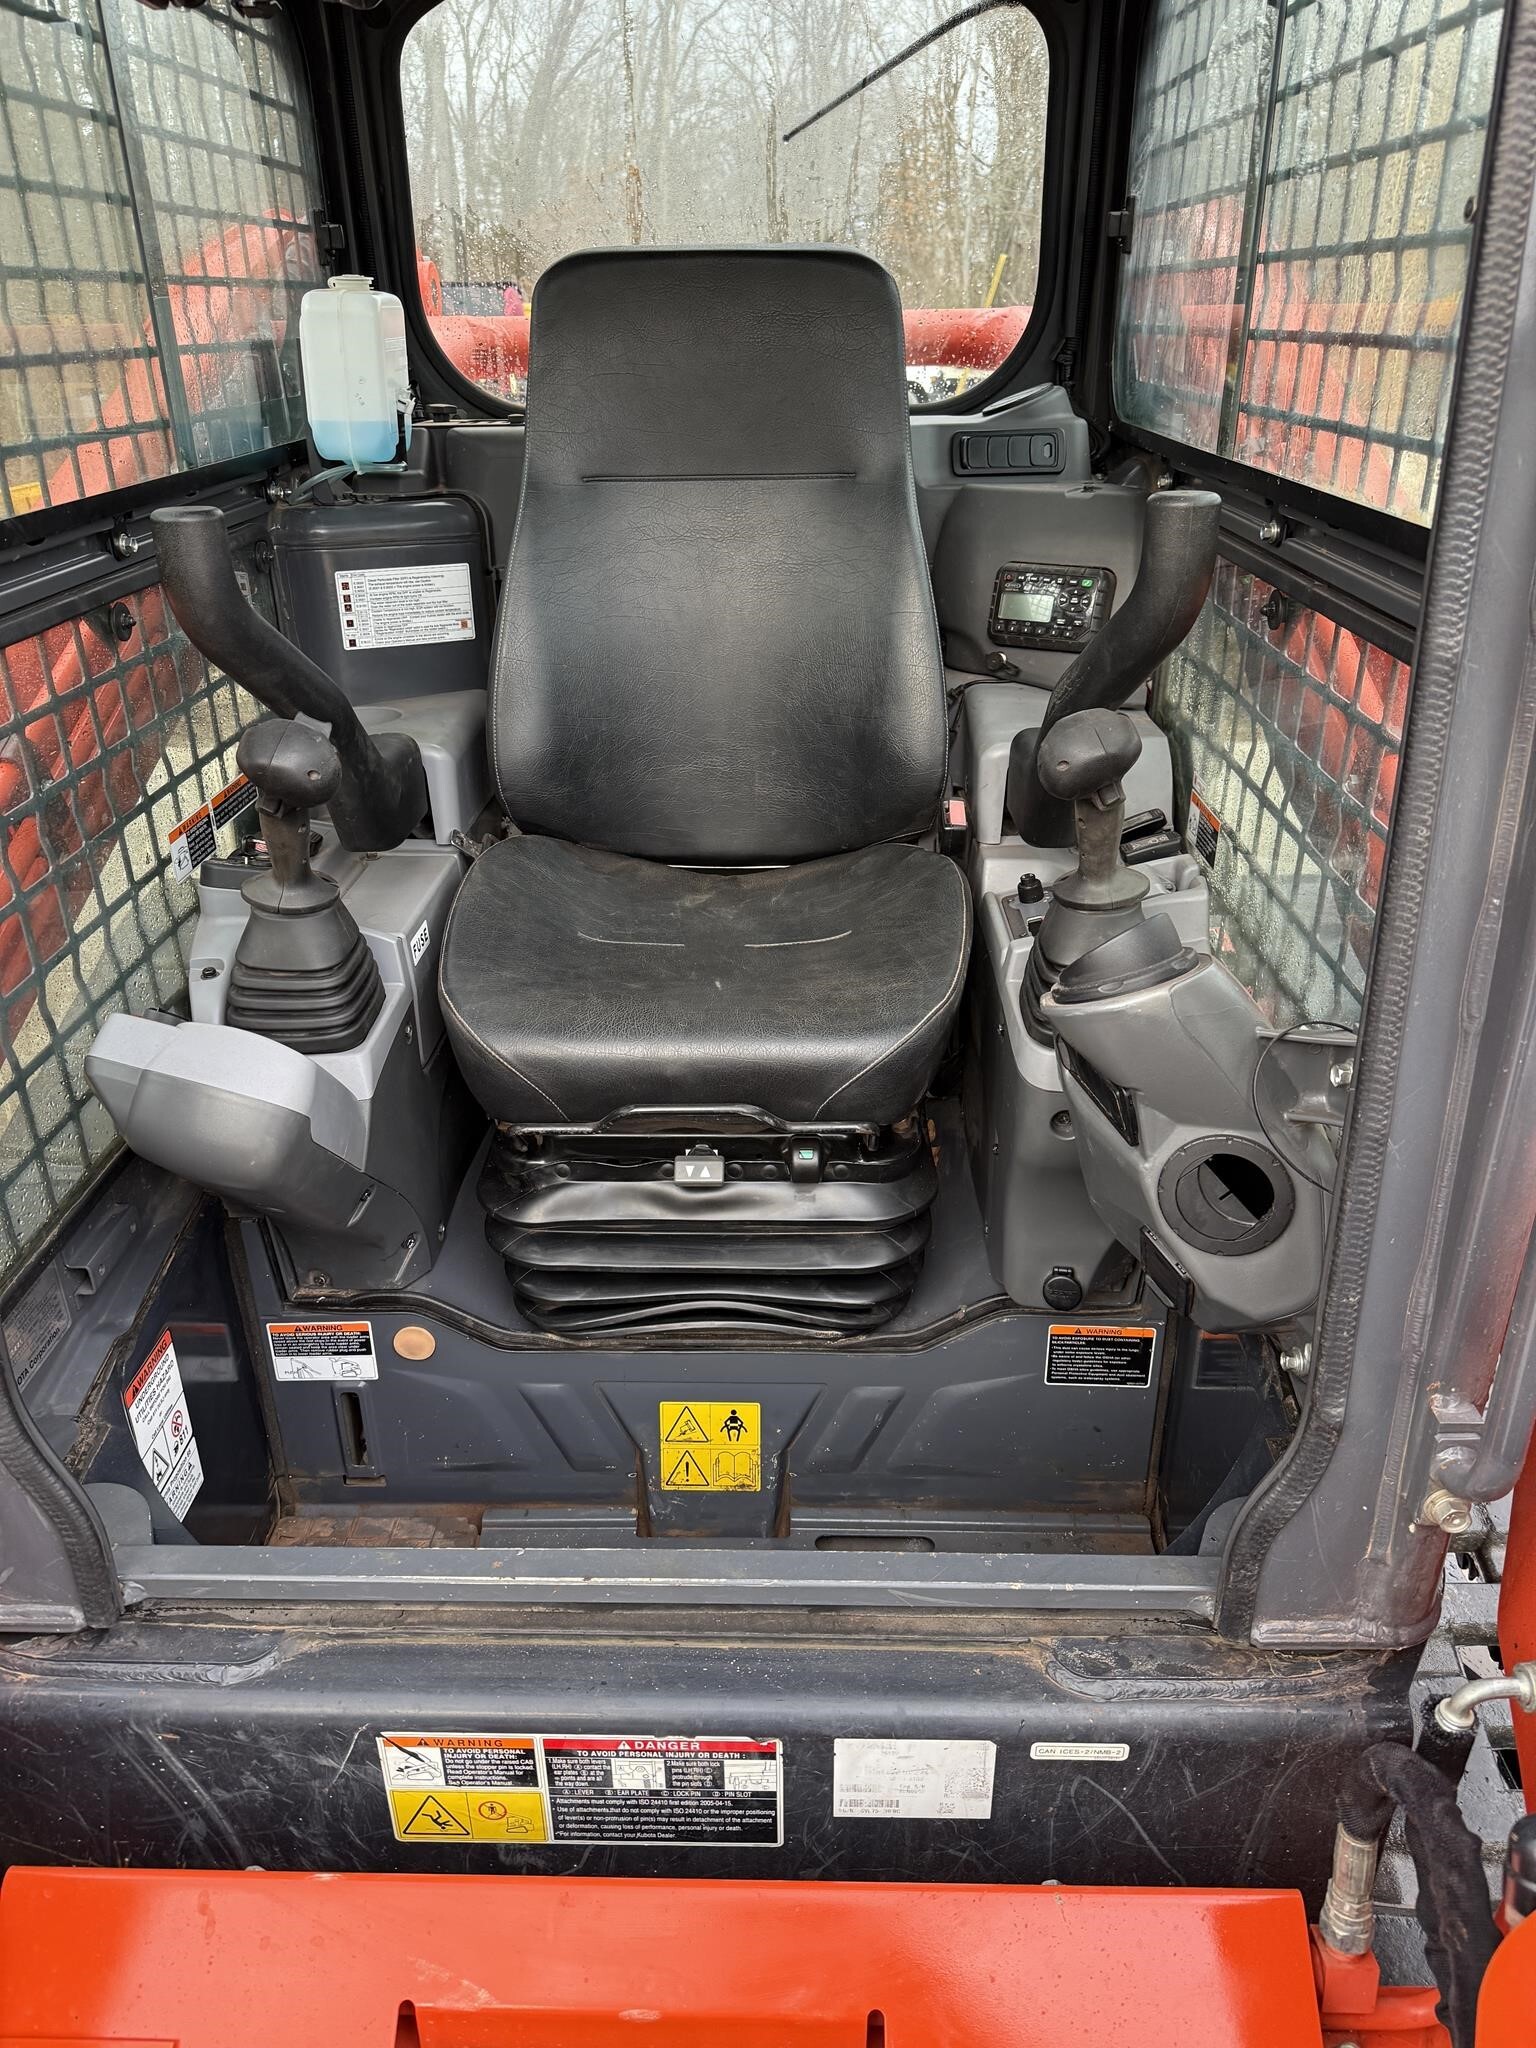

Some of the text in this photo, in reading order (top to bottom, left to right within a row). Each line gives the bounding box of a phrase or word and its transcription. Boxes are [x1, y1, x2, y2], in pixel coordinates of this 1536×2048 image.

[413, 928, 428, 958] FUSE
[30, 1328, 60, 1368] Corporation
[137, 1340, 167, 1386] WARNING
[135, 1354, 170, 1408] UNDERGROUND
[135, 1387, 157, 1423] UTILITIES
[157, 1360, 174, 1387] HAZARD
[179, 1425, 188, 1446] 811
[434, 1739, 502, 1747] WARNING
[635, 1741, 700, 1750] DANGER
